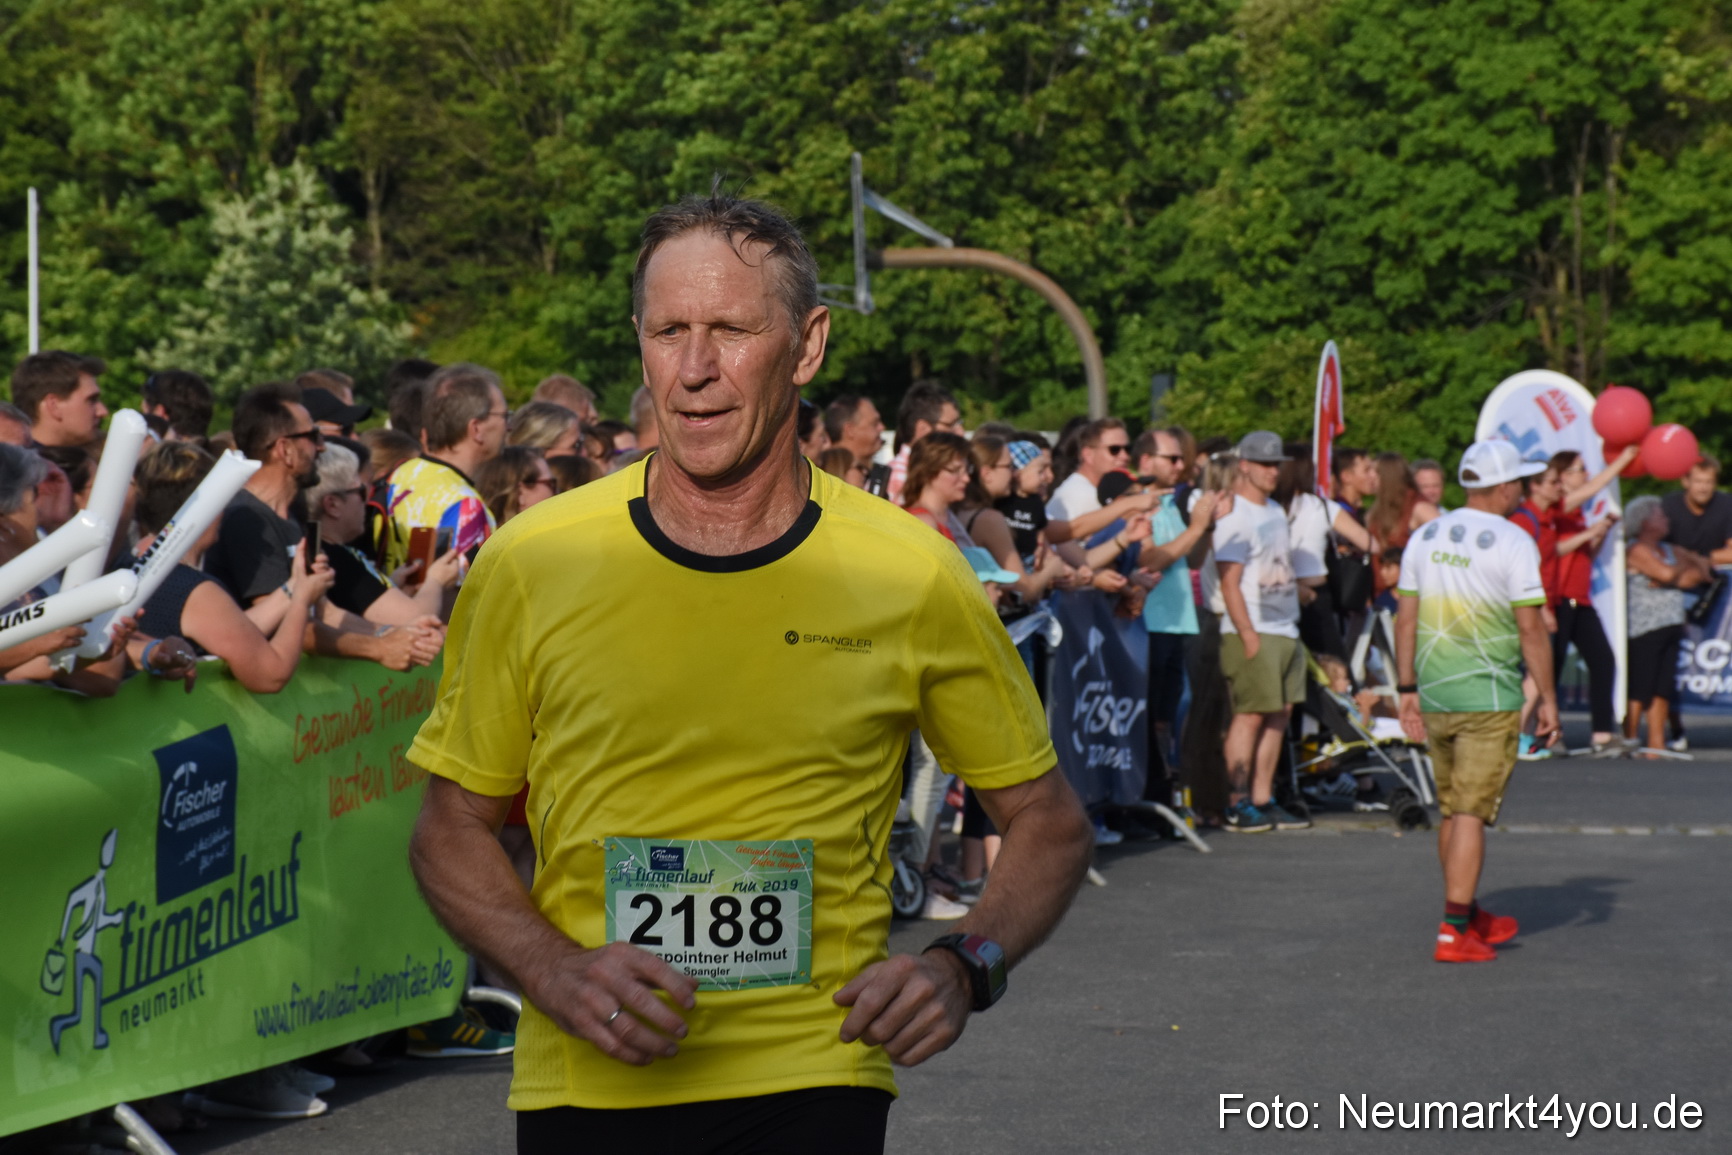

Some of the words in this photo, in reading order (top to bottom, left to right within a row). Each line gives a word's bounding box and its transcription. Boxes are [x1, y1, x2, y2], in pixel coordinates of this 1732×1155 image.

[1431, 550, 1472, 568] CREW
[803, 633, 872, 648] SPANGLER
[834, 646, 872, 655] AUTOMATION
[293, 683, 375, 764] Gesunde
[328, 751, 388, 820] laufen
[172, 779, 228, 819] Fischer
[176, 805, 223, 833] AUTOMOBILE
[636, 867, 716, 884] firmenlauf
[732, 880, 758, 893] run
[762, 879, 799, 893] 2019
[118, 830, 303, 995] firmenlauf
[629, 893, 783, 948] 2188
[656, 950, 730, 965] spointner
[733, 947, 788, 964] Helmut
[684, 966, 731, 979] Spangler
[119, 967, 205, 1034] neumarkt
